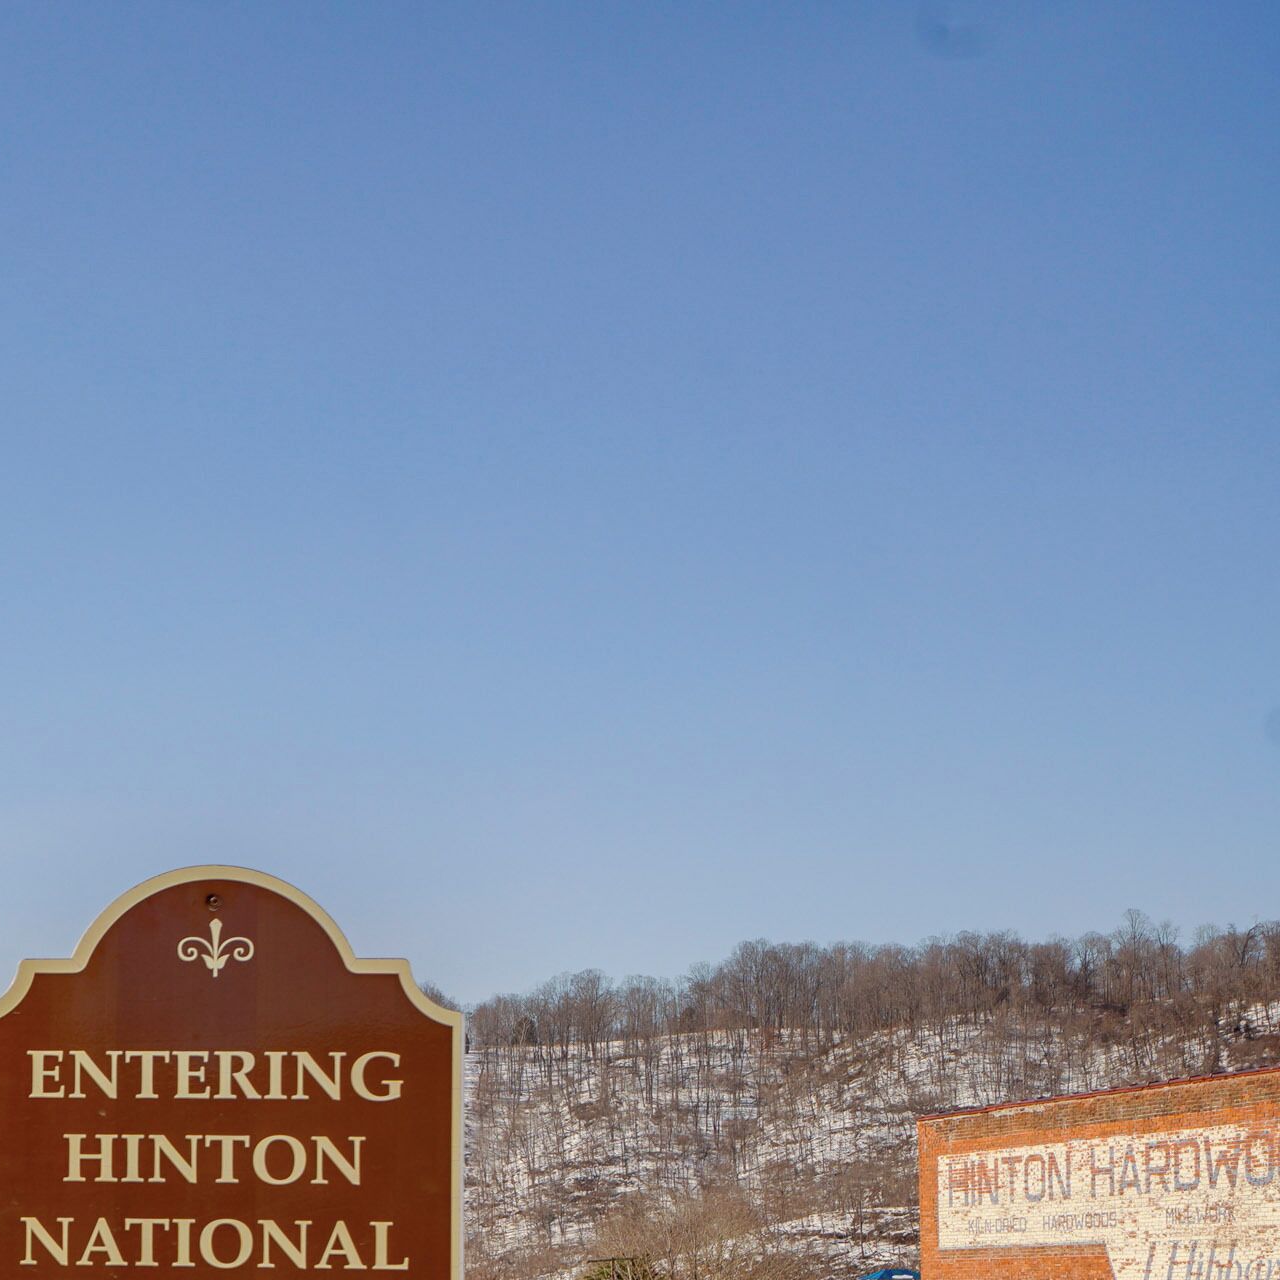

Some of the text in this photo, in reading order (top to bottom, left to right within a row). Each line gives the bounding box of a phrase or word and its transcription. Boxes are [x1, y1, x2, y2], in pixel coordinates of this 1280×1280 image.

[26, 1050, 402, 1101] ENTERING
[63, 1133, 366, 1184] HINTON
[948, 1130, 1280, 1207] HINTON HARDWO
[19, 1216, 409, 1269] NATIONAL
[1043, 1211, 1116, 1233] HARDWOODS
